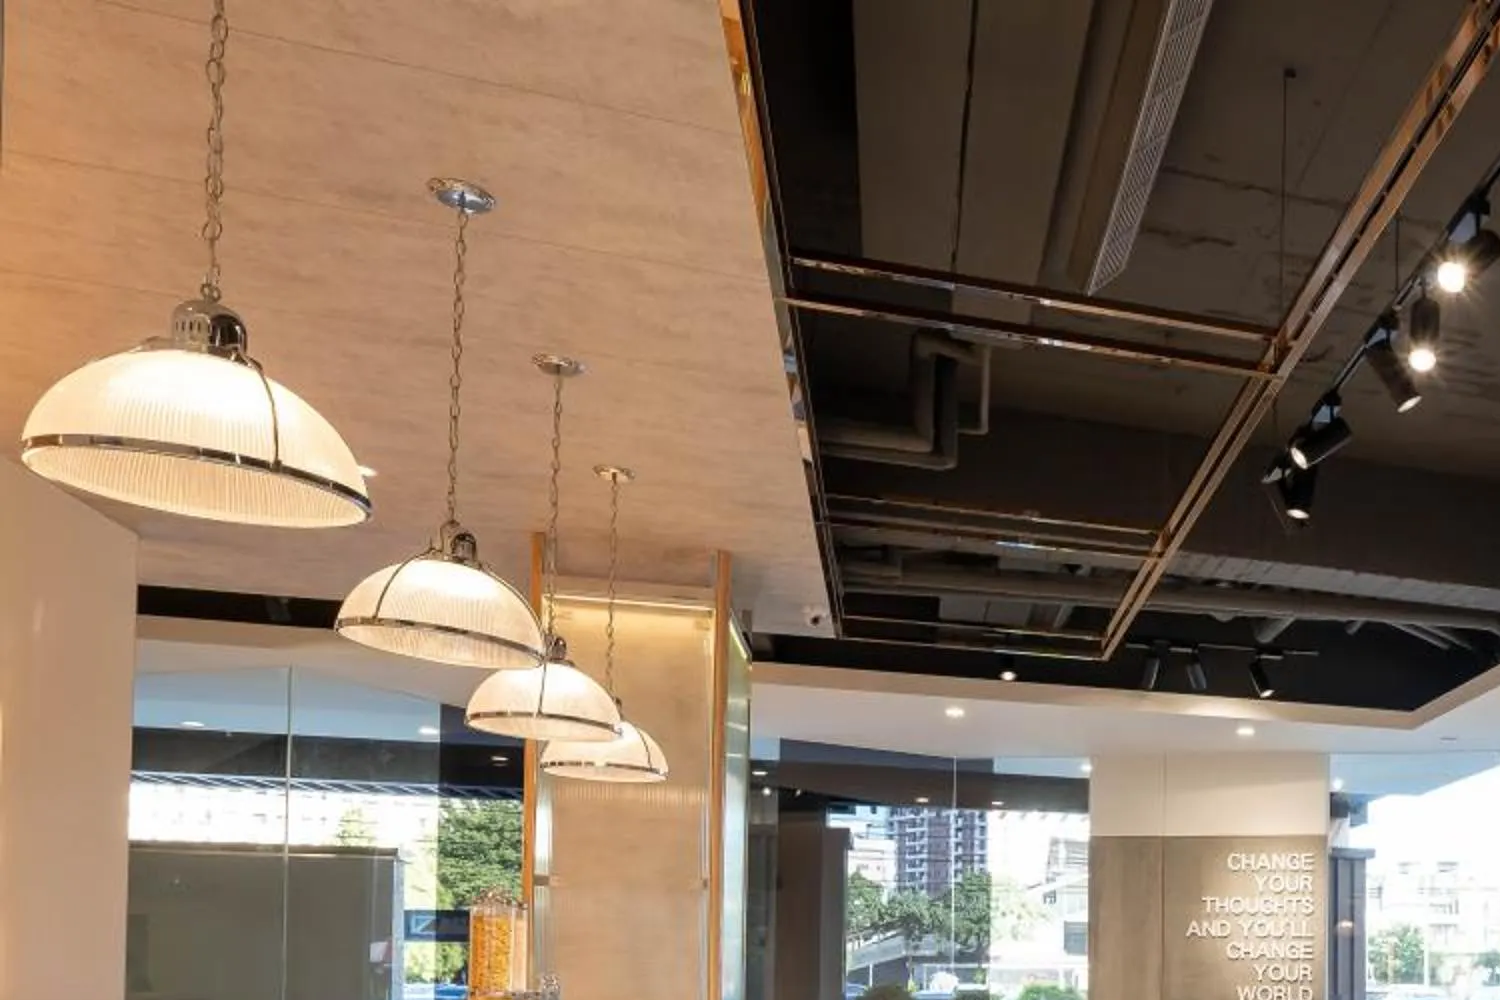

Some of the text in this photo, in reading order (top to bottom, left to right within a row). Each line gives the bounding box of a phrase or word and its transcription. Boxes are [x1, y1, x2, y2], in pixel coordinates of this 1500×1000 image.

[1227, 853, 1314, 871] CHANGE
[1254, 875, 1313, 892] YOUR
[1201, 896, 1314, 914] THOUGHTS
[1186, 920, 1231, 937] AND
[1226, 942, 1313, 960] CHANGE
[1253, 963, 1313, 981] YOUR
